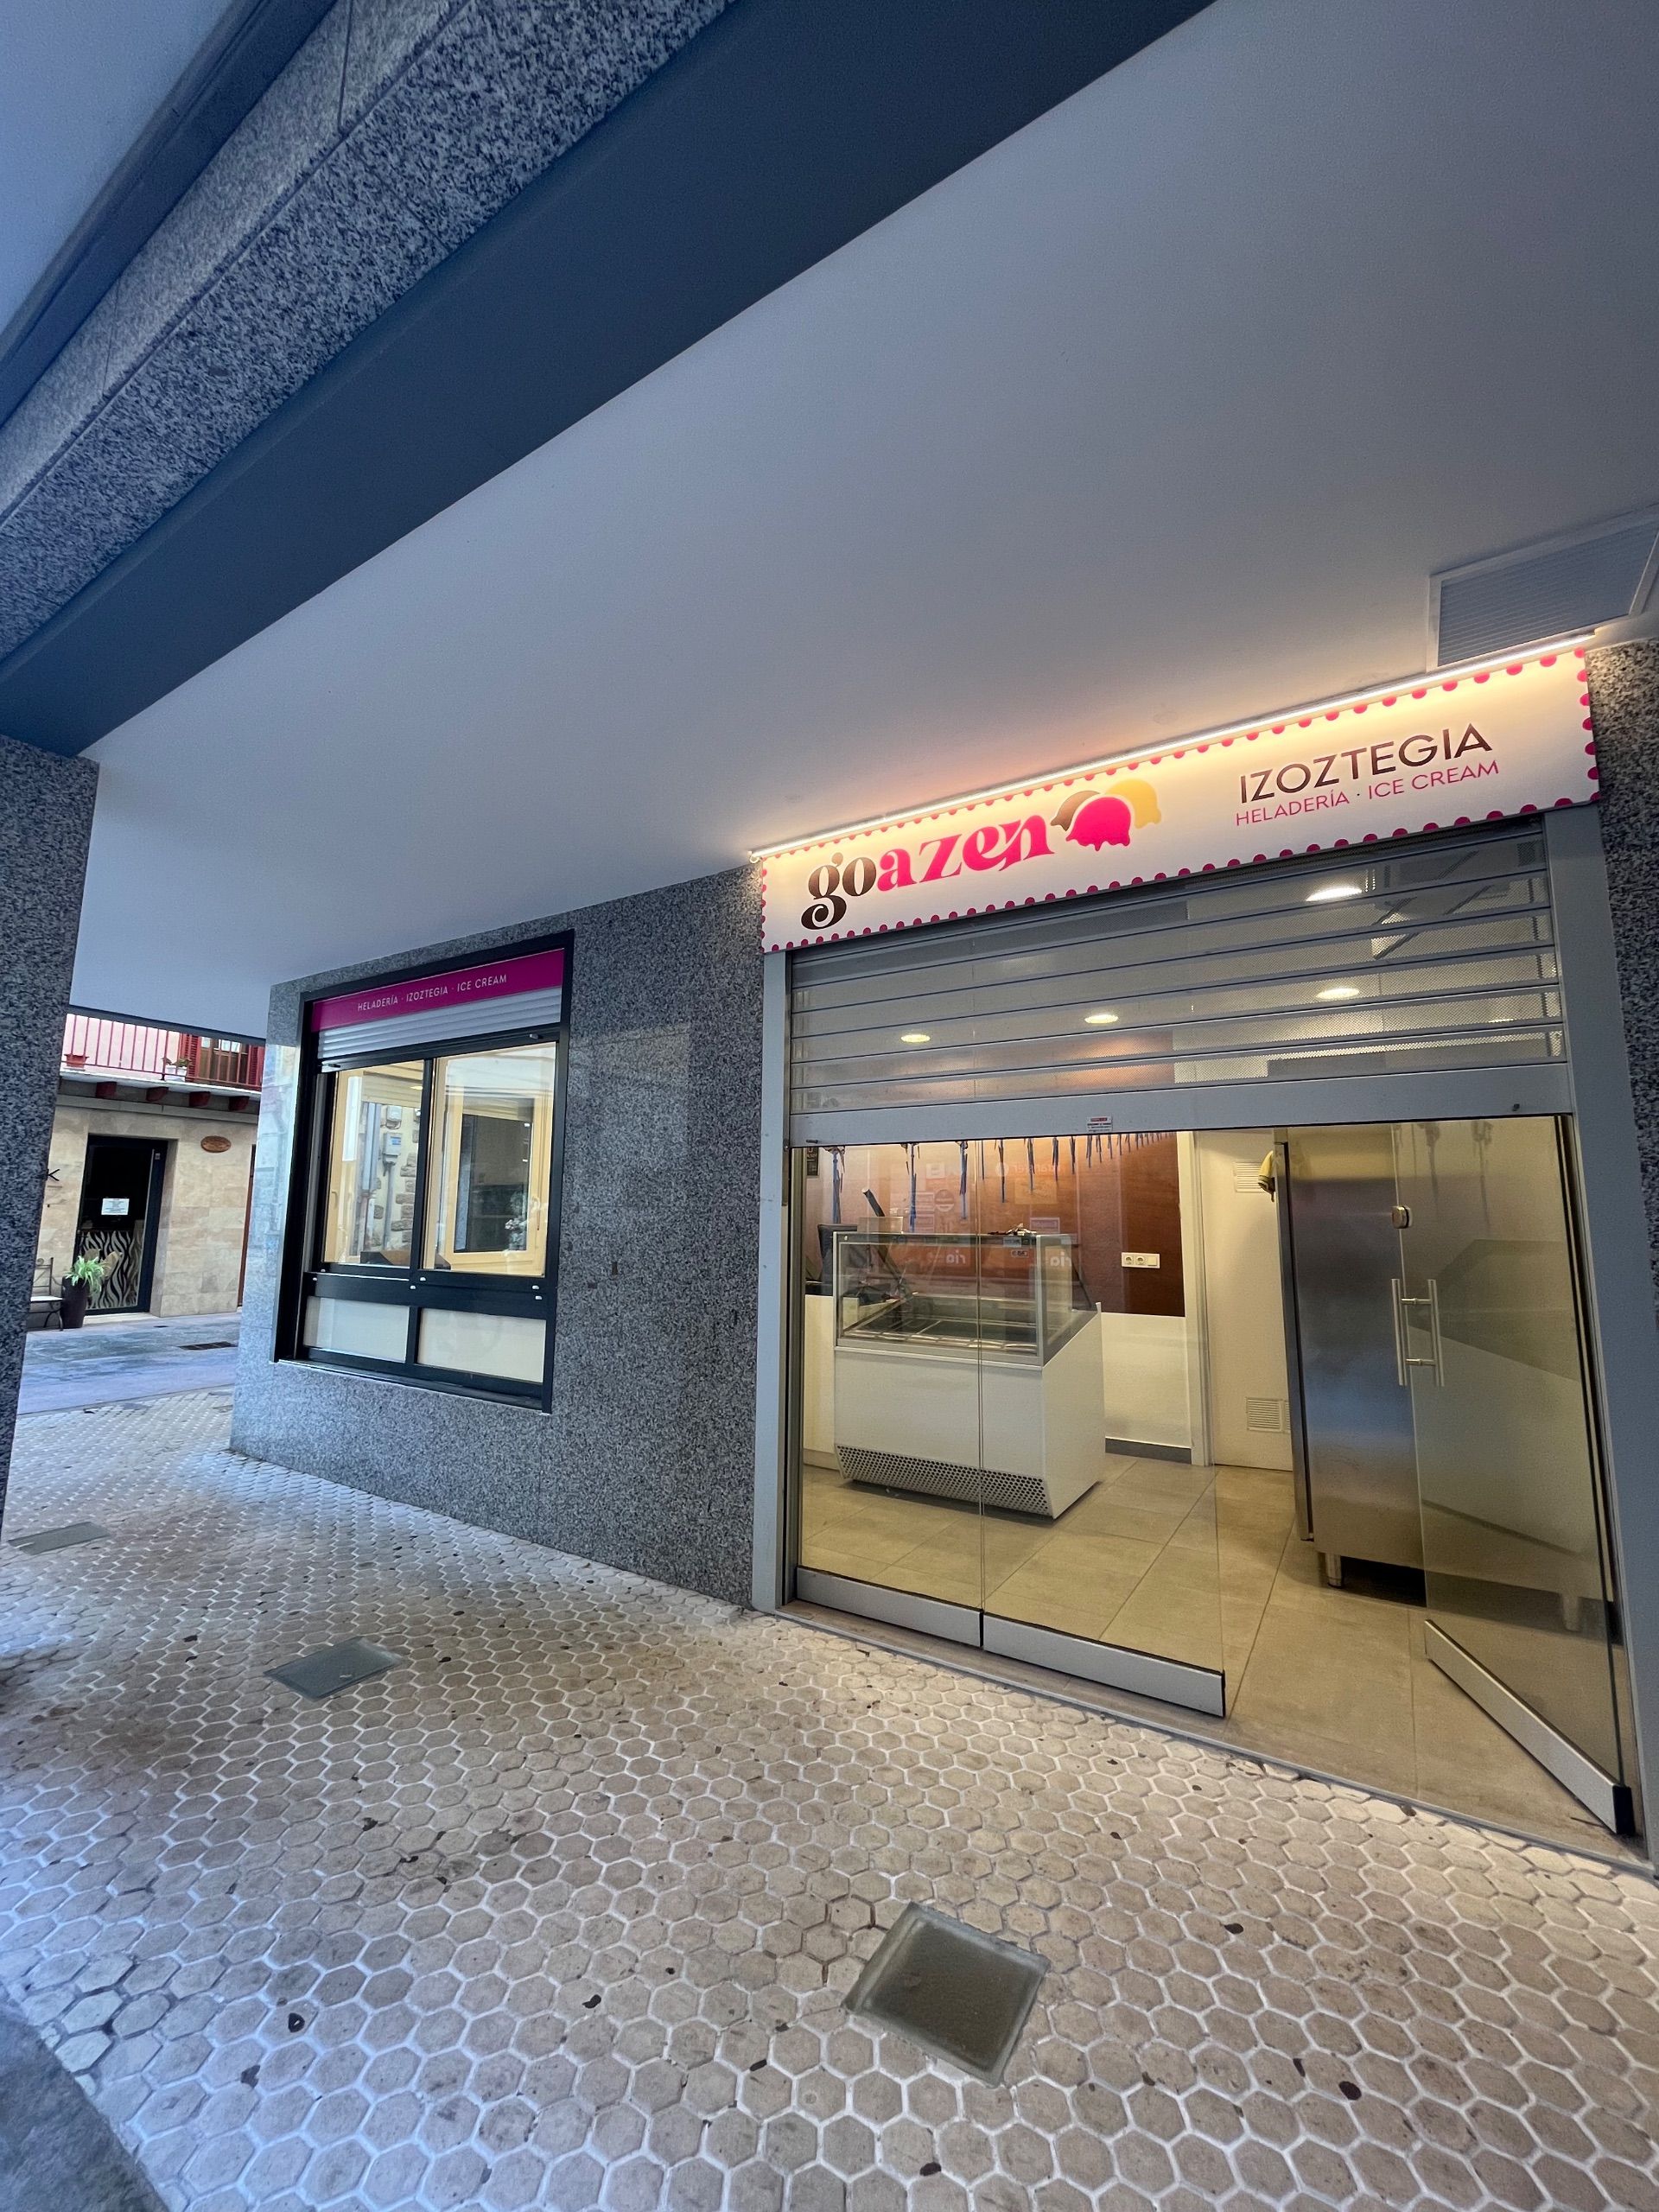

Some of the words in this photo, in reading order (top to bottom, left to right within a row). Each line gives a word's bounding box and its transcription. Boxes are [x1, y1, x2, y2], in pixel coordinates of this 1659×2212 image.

[1235, 789, 1350, 827] HELADERÍA
[1368, 779, 1405, 800] ICE
[1411, 760, 1500, 790] CREAM
[1240, 722, 1493, 804] IZOZTEGIA
[801, 815, 1056, 931] goazen
[357, 995, 398, 1012] HELADERÍA
[406, 986, 448, 1002] IZOZTEGIA
[457, 981, 472, 993] ICE
[475, 974, 507, 988] CREAM
